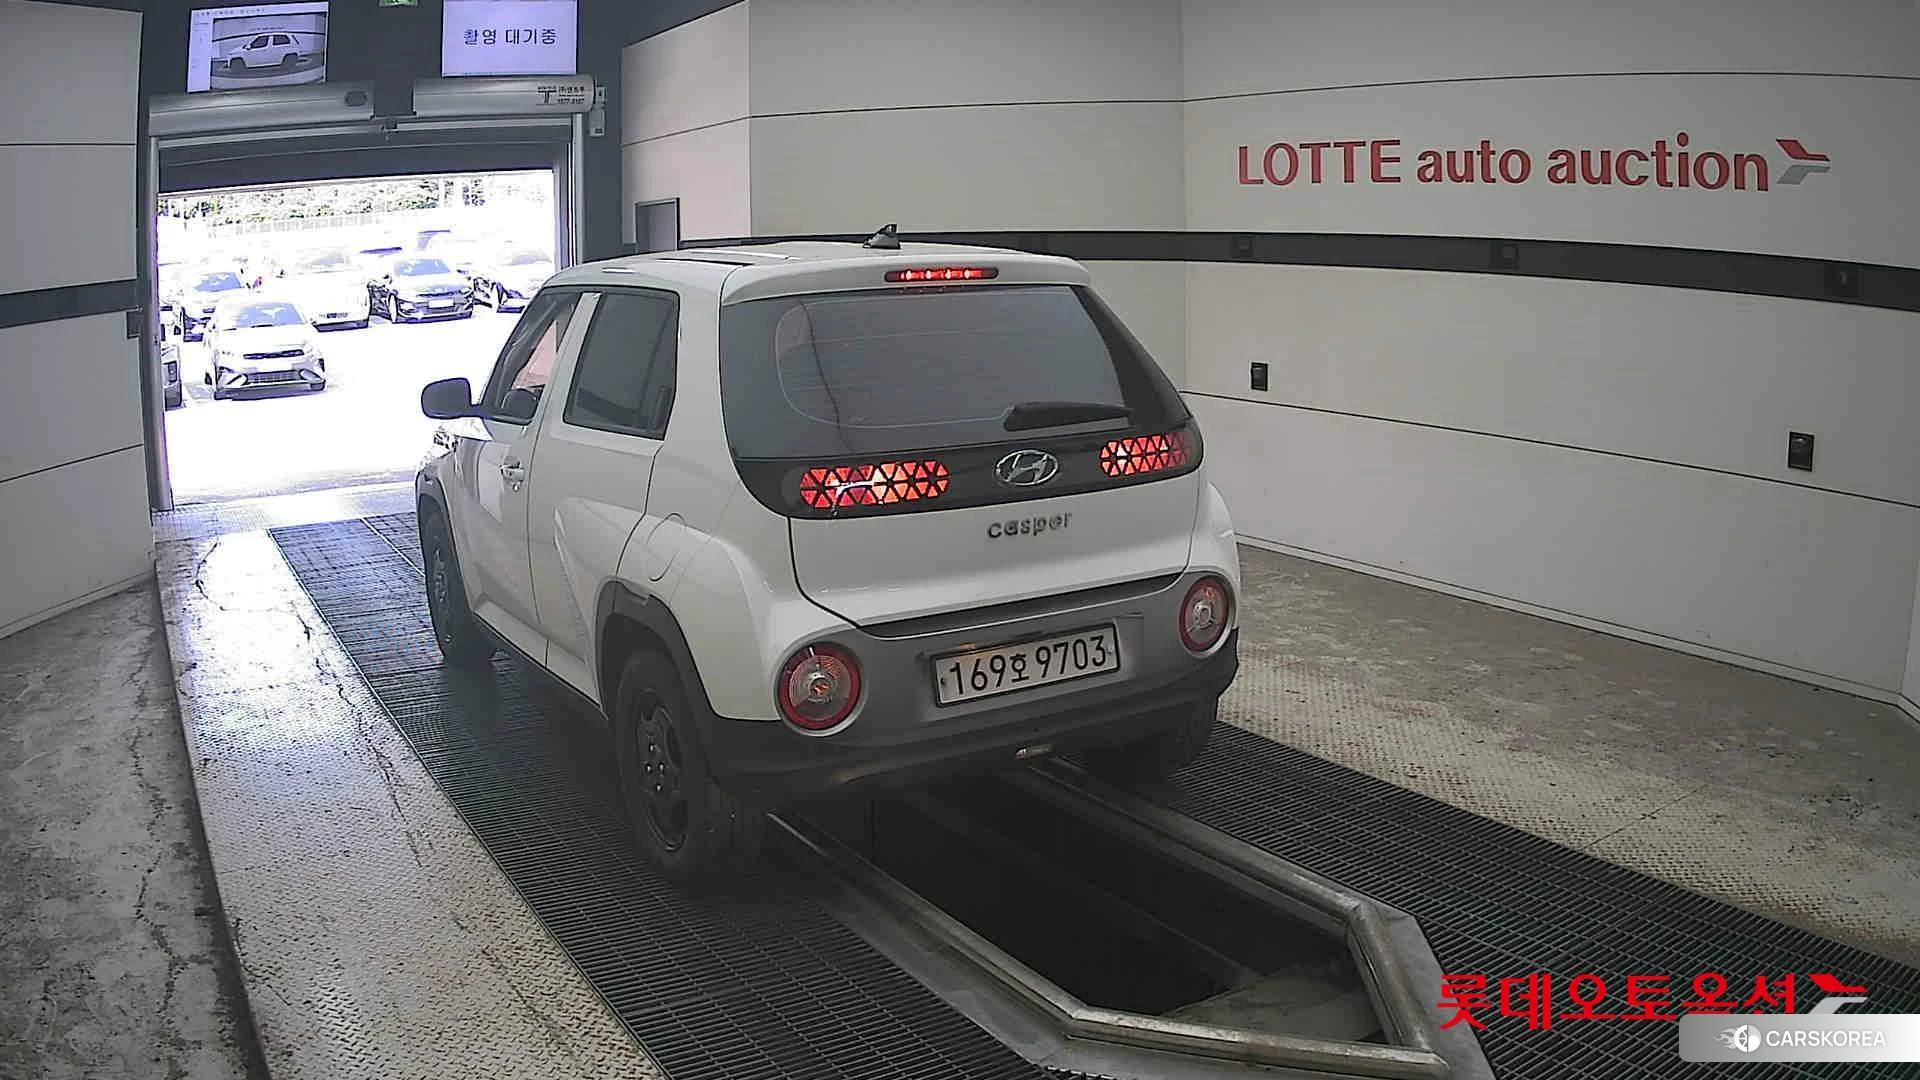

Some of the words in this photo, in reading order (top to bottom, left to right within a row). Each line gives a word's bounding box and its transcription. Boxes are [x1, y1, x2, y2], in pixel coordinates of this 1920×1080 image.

[463, 28, 497, 46] 촬영
[504, 28, 557, 46] 대기중
[1239, 139, 1401, 186] LOTTE
[1416, 139, 1531, 185] auto
[1546, 132, 1768, 192] auction
[949, 654, 1030, 695] 169호
[1035, 634, 1106, 679] 9703
